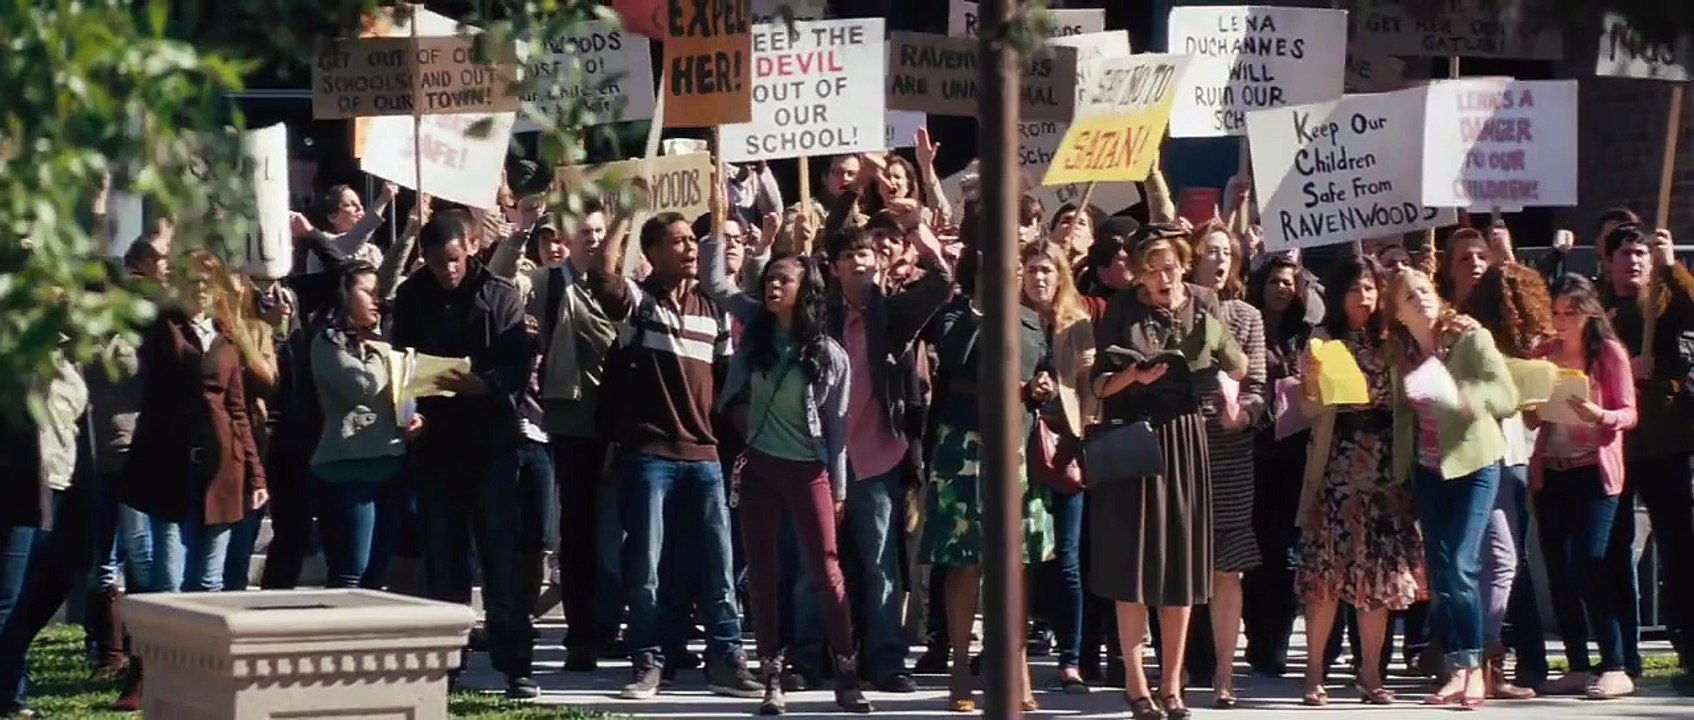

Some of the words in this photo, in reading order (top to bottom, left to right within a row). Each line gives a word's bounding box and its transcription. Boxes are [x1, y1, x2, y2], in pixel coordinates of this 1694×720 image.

[1218, 14, 1276, 33] LENA
[752, 28, 800, 52] EEP
[812, 25, 864, 47] THE
[1185, 36, 1305, 59] DUCHANNES
[416, 48, 441, 65] OF
[756, 50, 843, 78] DEVIL
[420, 70, 452, 89] AND
[460, 66, 496, 86] OUT
[671, 51, 742, 96] HER!
[1228, 61, 1275, 82] WILL
[752, 81, 805, 103] OUT
[815, 77, 848, 98] OF
[892, 74, 928, 96] ARE
[1241, 85, 1286, 106] OUR
[373, 93, 414, 111] OUR
[426, 86, 492, 109] TOWN!
[1518, 88, 1535, 108] A
[774, 104, 829, 127] OUR
[1214, 109, 1246, 130] SCH
[1293, 110, 1339, 146] Keep
[1352, 113, 1388, 134] Our
[1461, 116, 1533, 144] DANGER
[745, 127, 859, 160] SCHOOL!
[1063, 125, 1153, 170] SATAN!
[1295, 146, 1377, 176] Children
[1465, 150, 1485, 170] TO
[1488, 150, 1526, 171] OUR
[1303, 181, 1347, 209] Safe
[1352, 177, 1393, 198] From
